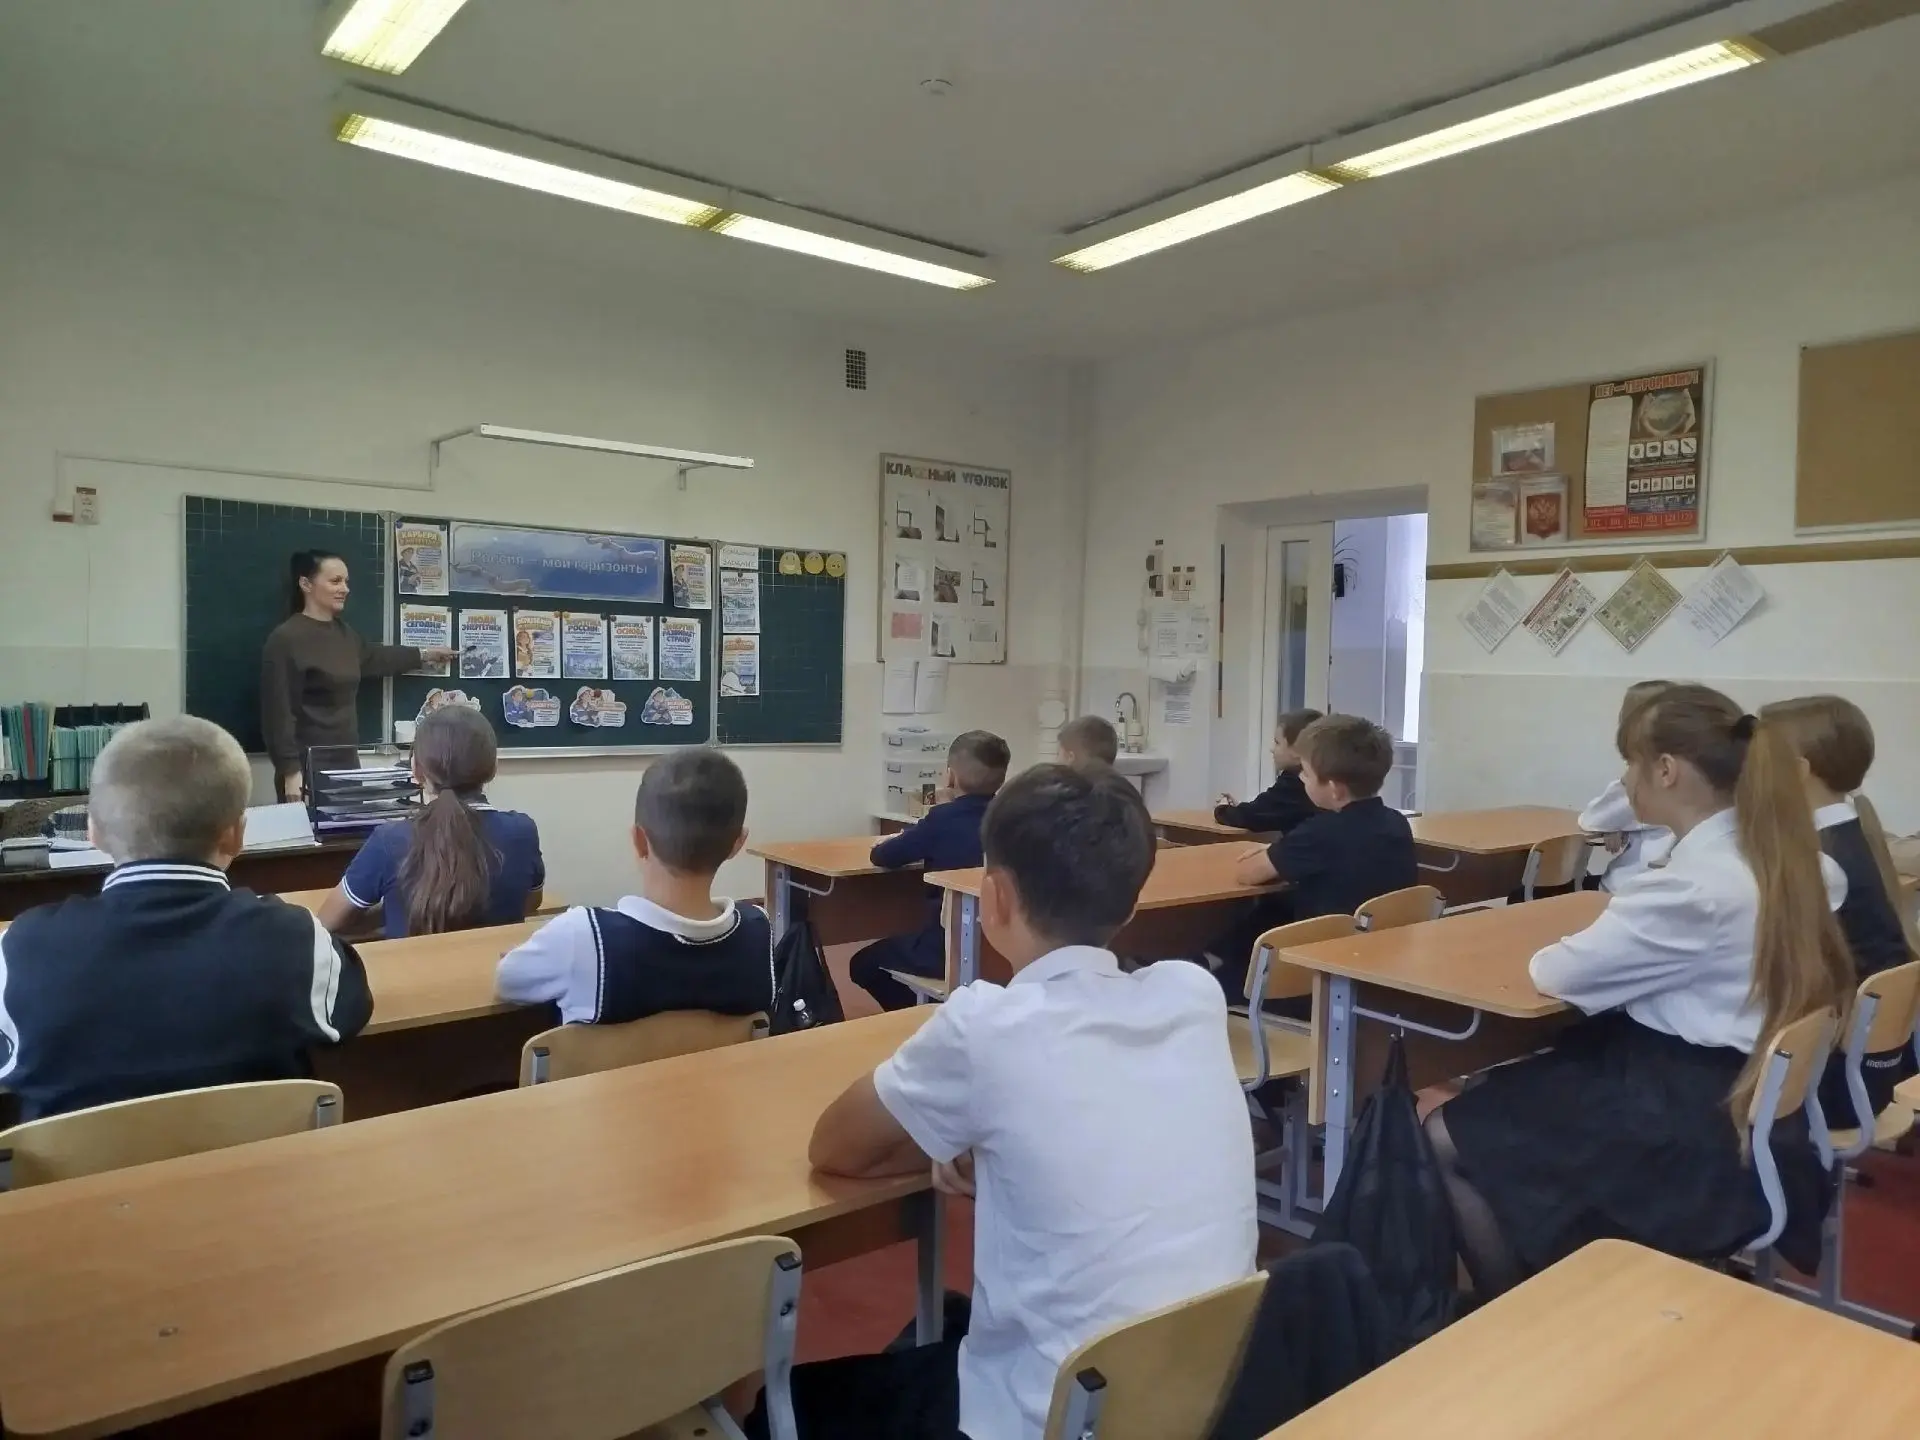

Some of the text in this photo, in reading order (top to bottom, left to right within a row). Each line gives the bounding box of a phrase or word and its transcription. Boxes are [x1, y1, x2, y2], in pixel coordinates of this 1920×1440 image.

[471, 550, 525, 566] Россия
[542, 556, 572, 569] мои
[574, 559, 648, 575] горизонты
